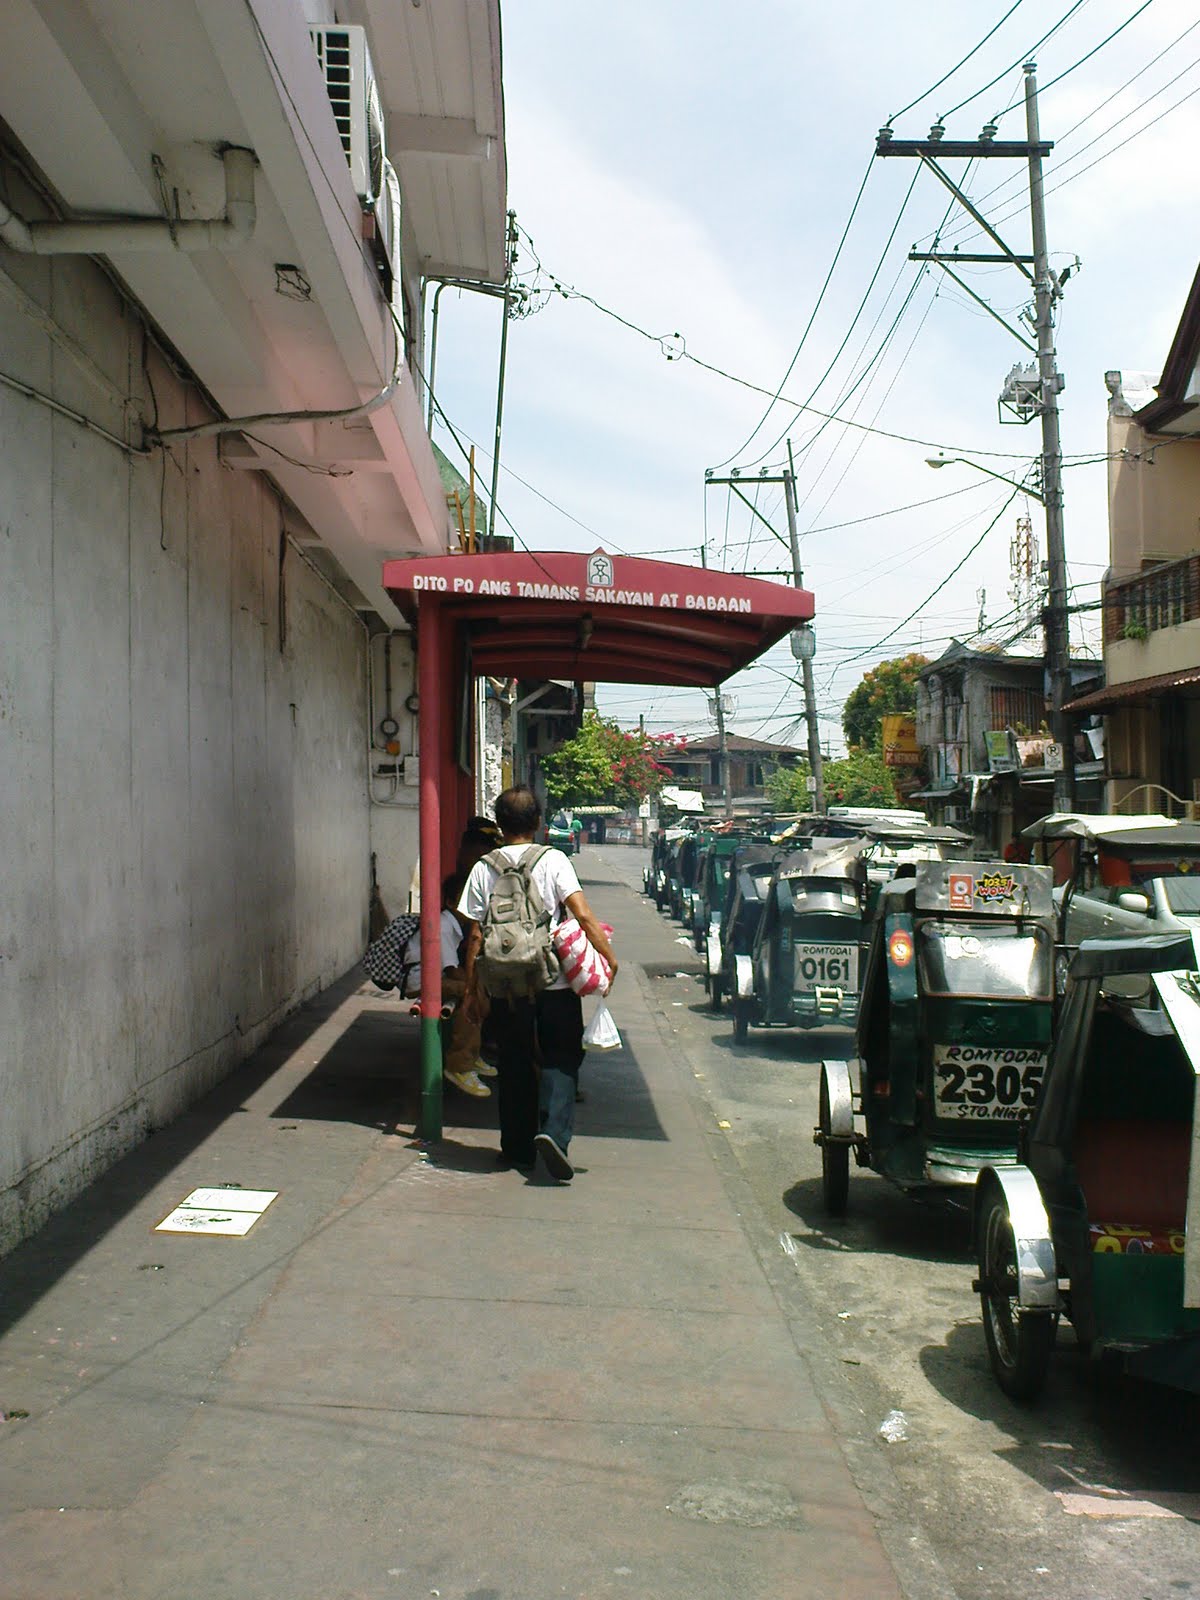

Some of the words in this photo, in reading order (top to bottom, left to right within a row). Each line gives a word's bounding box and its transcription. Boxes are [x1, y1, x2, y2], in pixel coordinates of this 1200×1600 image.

[413, 575, 448, 591] DITO
[454, 578, 474, 593] PO
[479, 580, 511, 596] ANG
[517, 582, 579, 601] TAMANG
[585, 587, 653, 606] SAKAYAN
[660, 593, 679, 608] AT
[685, 595, 752, 613] BABAAN
[801, 957, 849, 981] 0161
[939, 1063, 1043, 1106] 2305
